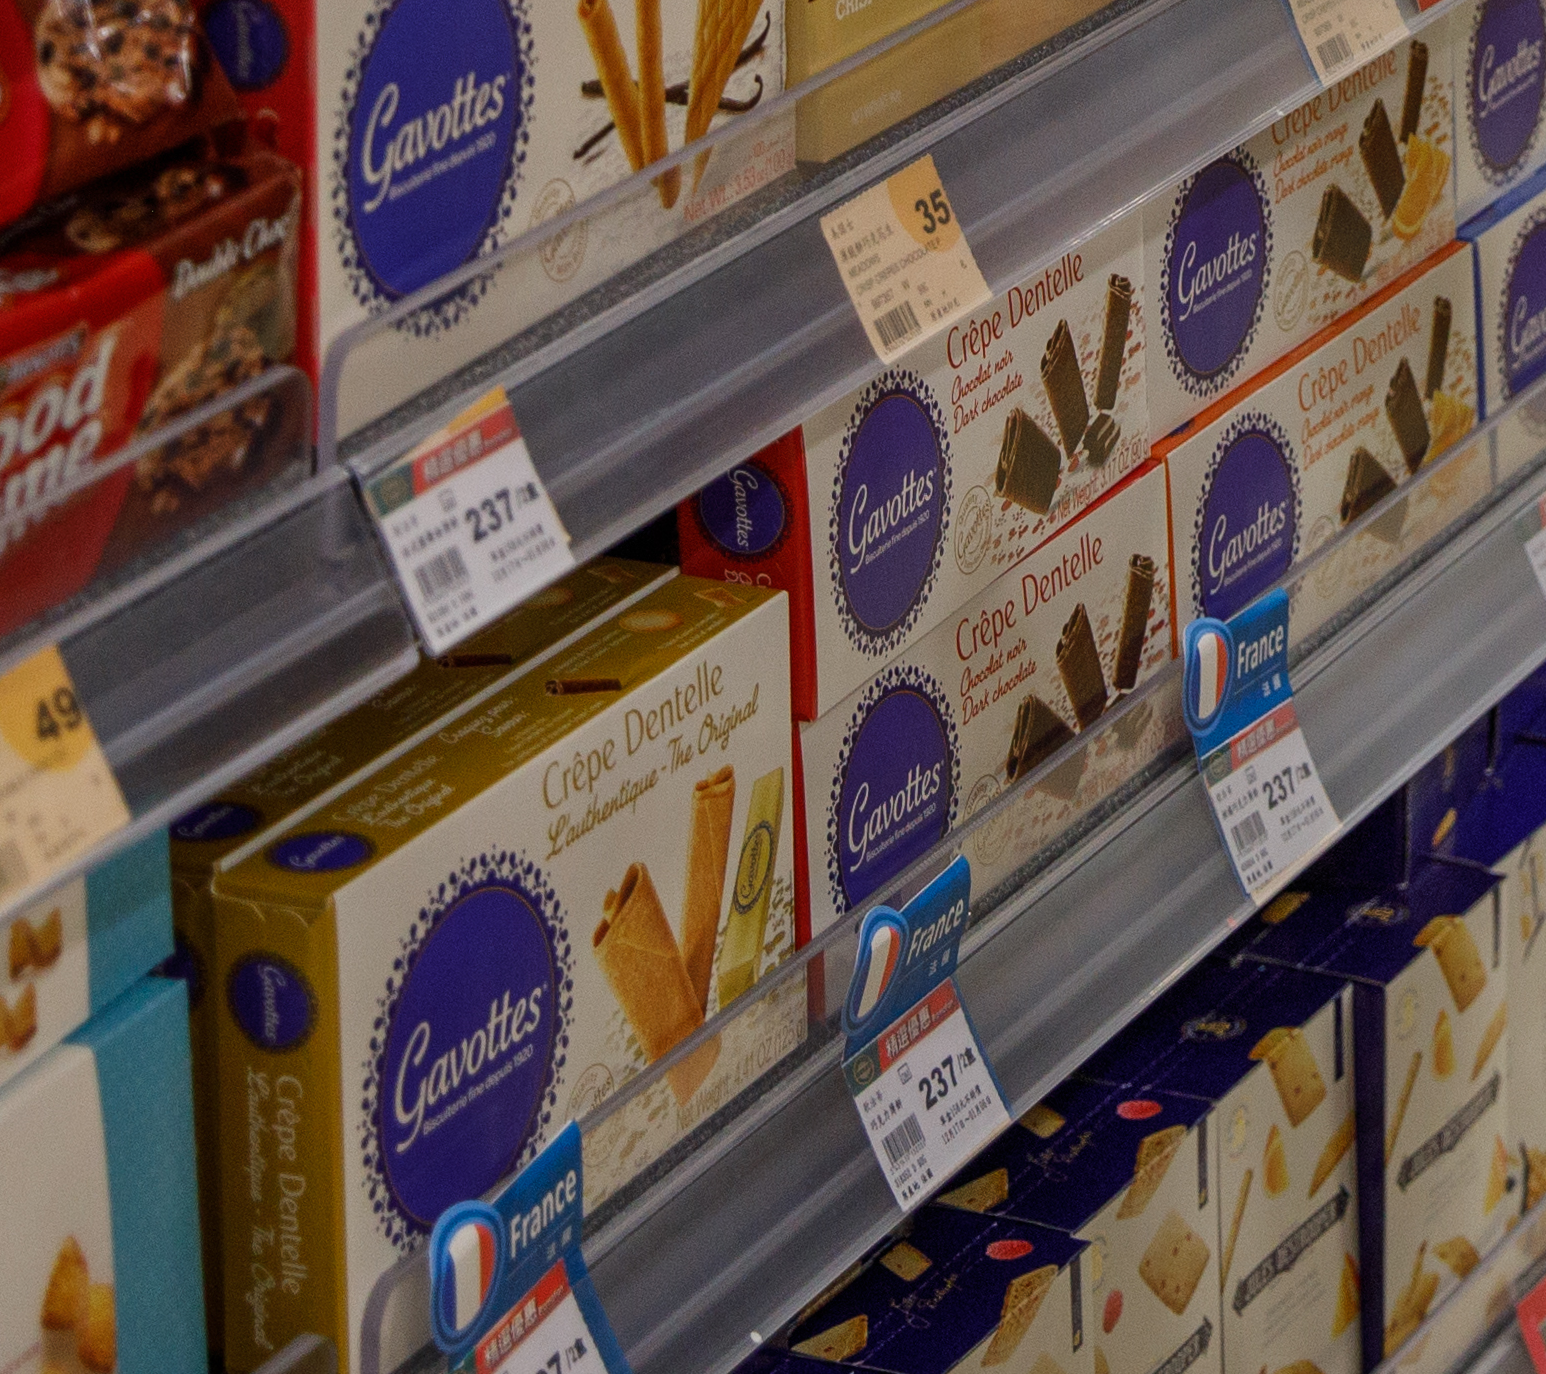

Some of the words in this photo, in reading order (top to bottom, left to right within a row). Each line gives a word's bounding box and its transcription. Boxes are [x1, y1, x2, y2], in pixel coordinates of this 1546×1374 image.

[362, 74, 510, 213] Gavottes
[915, 189, 951, 234] 35
[945, 299, 1004, 368] Crêpe
[1007, 251, 1085, 326] Dentelle
[1178, 233, 1256, 321] Gavottes
[951, 372, 991, 405] Chocolat
[994, 350, 1014, 375] noir
[1297, 356, 1348, 412] Crêpe
[1351, 302, 1420, 361] Dentelle
[954, 404, 978, 434] Dark
[981, 374, 1024, 413] chocolate
[848, 468, 934, 574] Gavottes
[1207, 504, 1286, 596] Gavottes
[955, 591, 1022, 662] Crêpe
[1025, 534, 1103, 605] Dentelle
[958, 654, 998, 699] Chocolat
[1001, 637, 1028, 674] noir
[1237, 623, 1285, 673] France
[34, 684, 83, 743] 49
[542, 739, 615, 809] Crêpe
[624, 661, 724, 754] Dentelle
[963, 690, 992, 727] Dark
[994, 660, 1037, 707] chocolate
[547, 764, 659, 861] L'authentique
[667, 735, 694, 776] The
[697, 683, 760, 752] Original
[1262, 767, 1295, 810] 237
[847, 760, 944, 873] Gavottes
[907, 898, 965, 964] France
[930, 948, 953, 976] 法國
[395, 985, 543, 1153] Gavottes
[919, 1055, 958, 1111] 237
[510, 1168, 577, 1258] France
